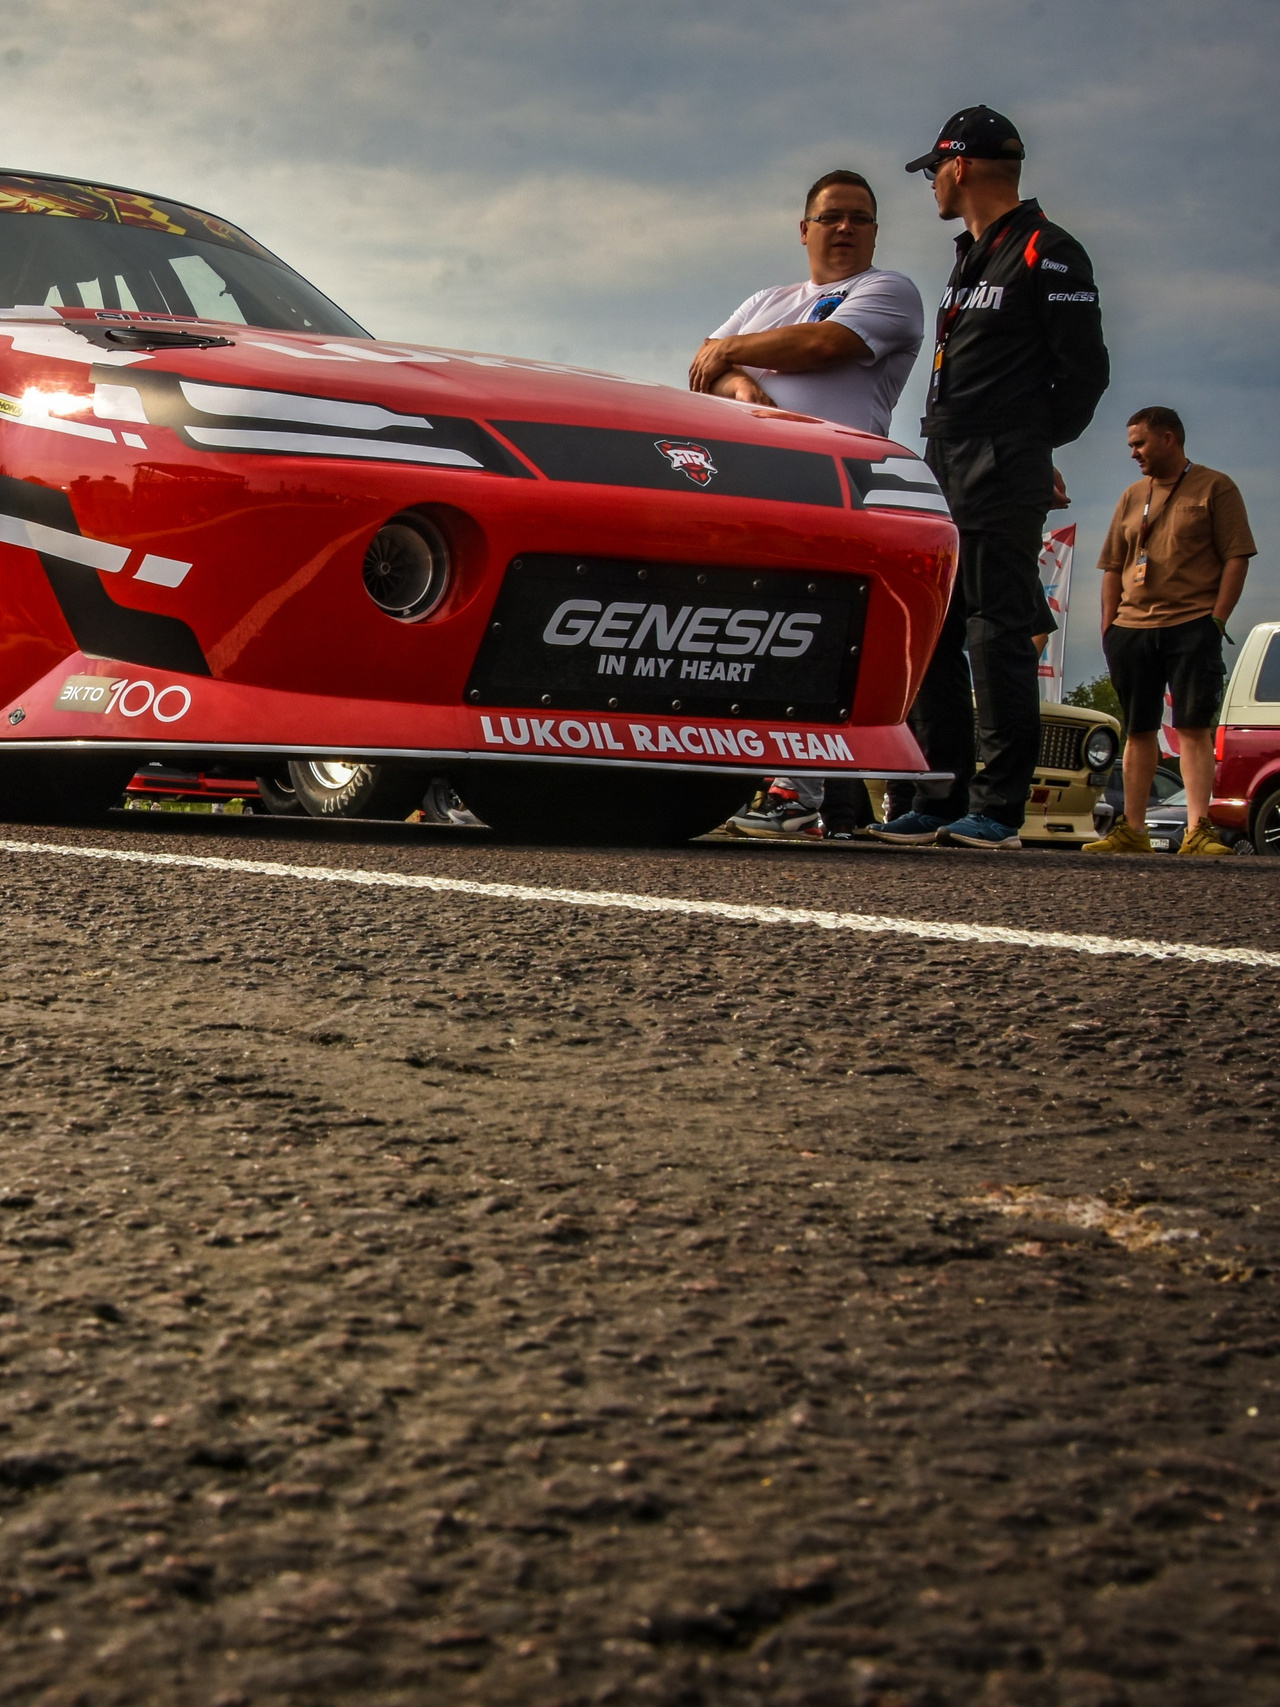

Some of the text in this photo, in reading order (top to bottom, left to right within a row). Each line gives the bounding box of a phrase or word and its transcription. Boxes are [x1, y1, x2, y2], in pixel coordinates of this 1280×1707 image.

[1048, 292, 1097, 302] GENESIS
[542, 599, 821, 657] GENESIS
[597, 654, 755, 682] IN MY HEART
[60, 679, 192, 722] ЭКТО 100
[480, 716, 854, 761] LUKOIL RACING TEAM
